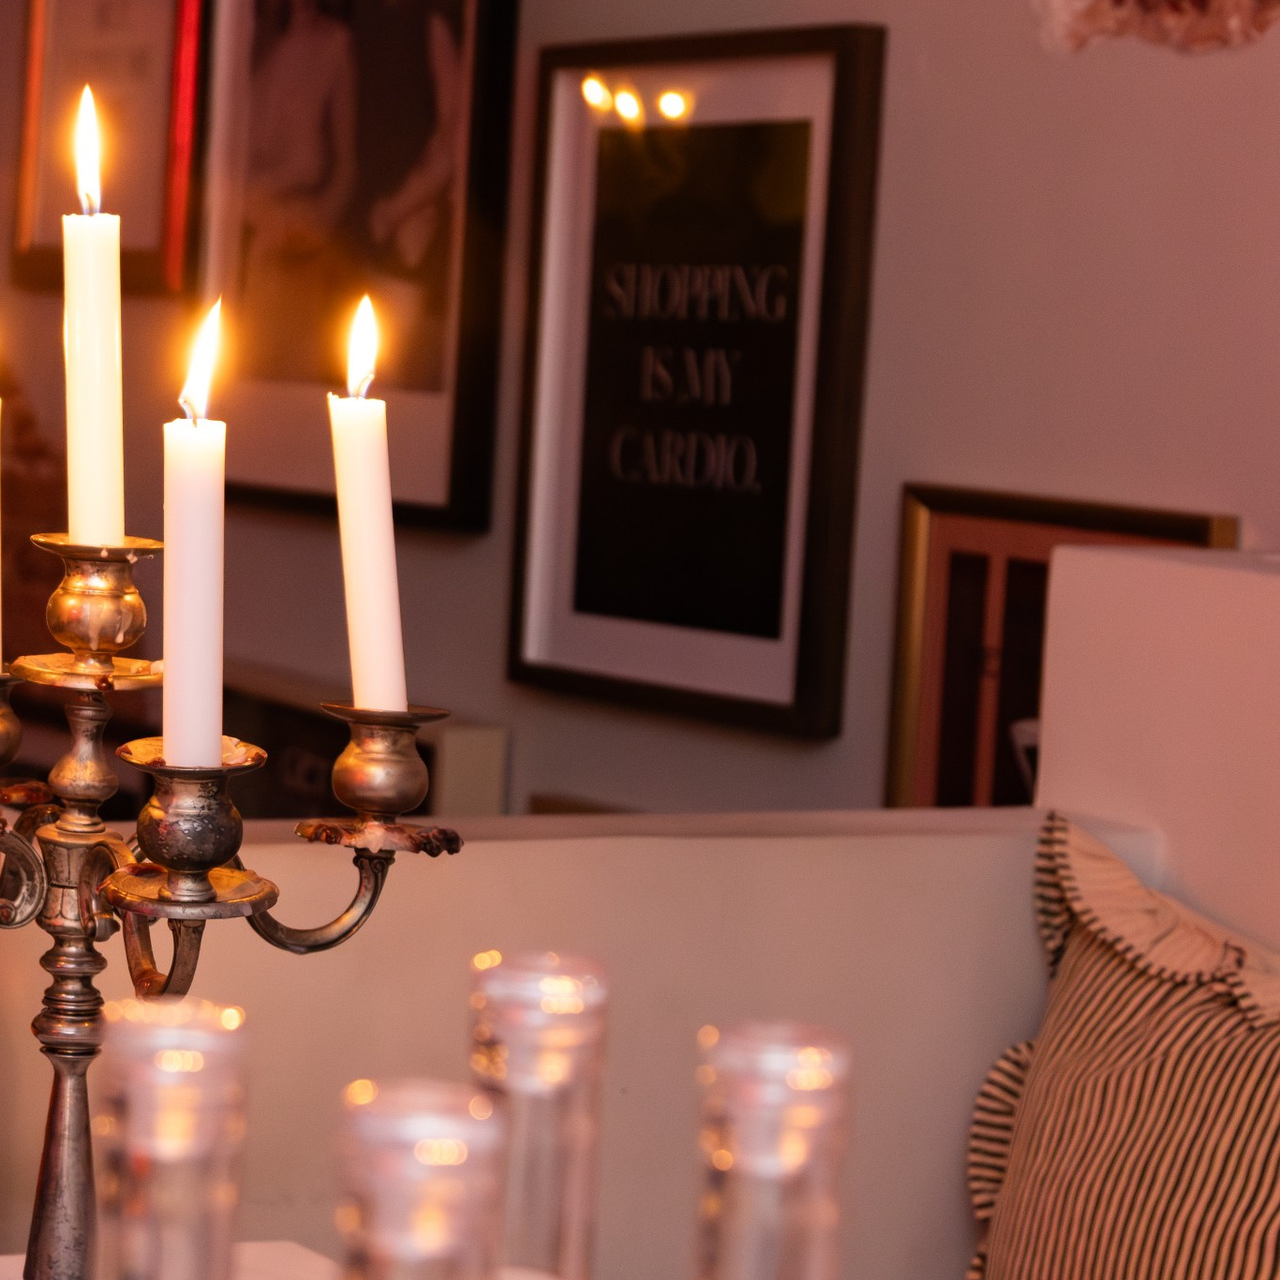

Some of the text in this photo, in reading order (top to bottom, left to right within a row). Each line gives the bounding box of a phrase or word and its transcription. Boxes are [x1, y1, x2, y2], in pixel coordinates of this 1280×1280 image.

[604, 262, 789, 323] SHOPPING
[640, 344, 743, 407] IS MY
